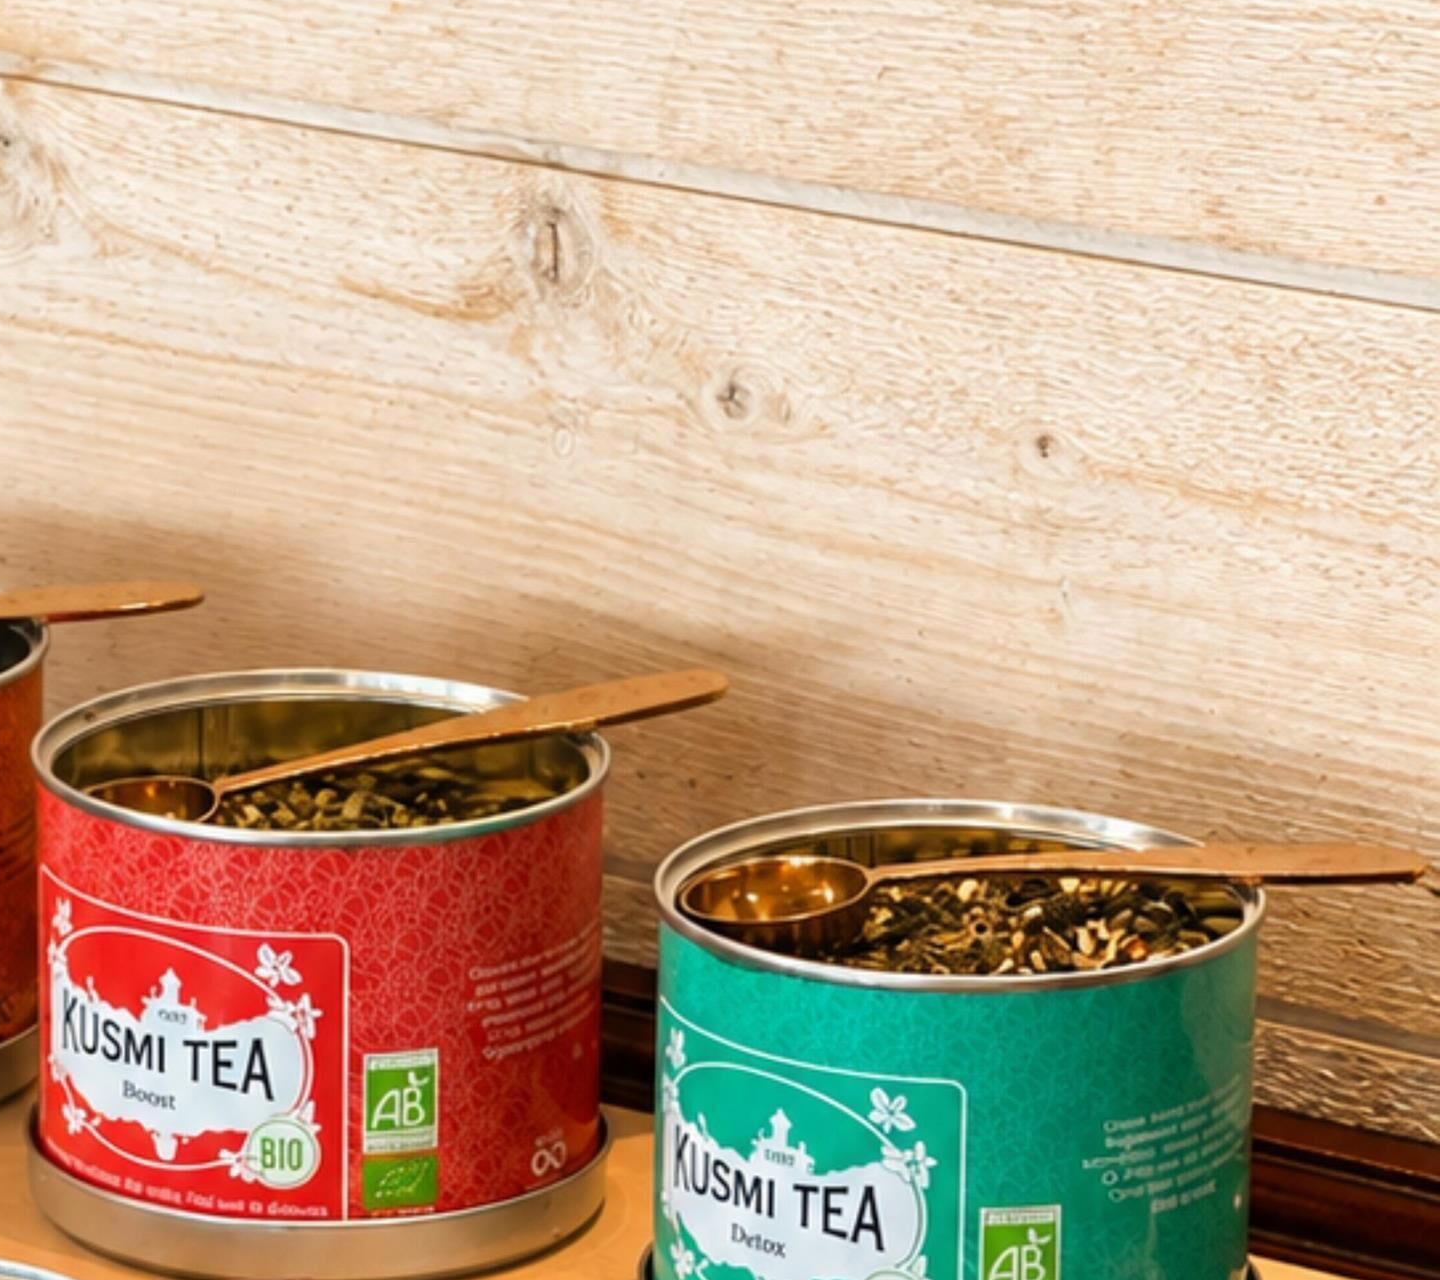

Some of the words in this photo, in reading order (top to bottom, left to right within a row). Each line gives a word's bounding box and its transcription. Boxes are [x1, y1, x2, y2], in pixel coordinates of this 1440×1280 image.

[62, 987, 166, 1074] KUSMI
[182, 1037, 275, 1103] TEA
[121, 1079, 177, 1111] Boost
[371, 1086, 426, 1130] AB
[260, 1136, 304, 1172] BIO
[673, 1123, 776, 1219] KUSMI
[793, 1184, 886, 1254] TEA
[731, 1222, 787, 1259] Detox
